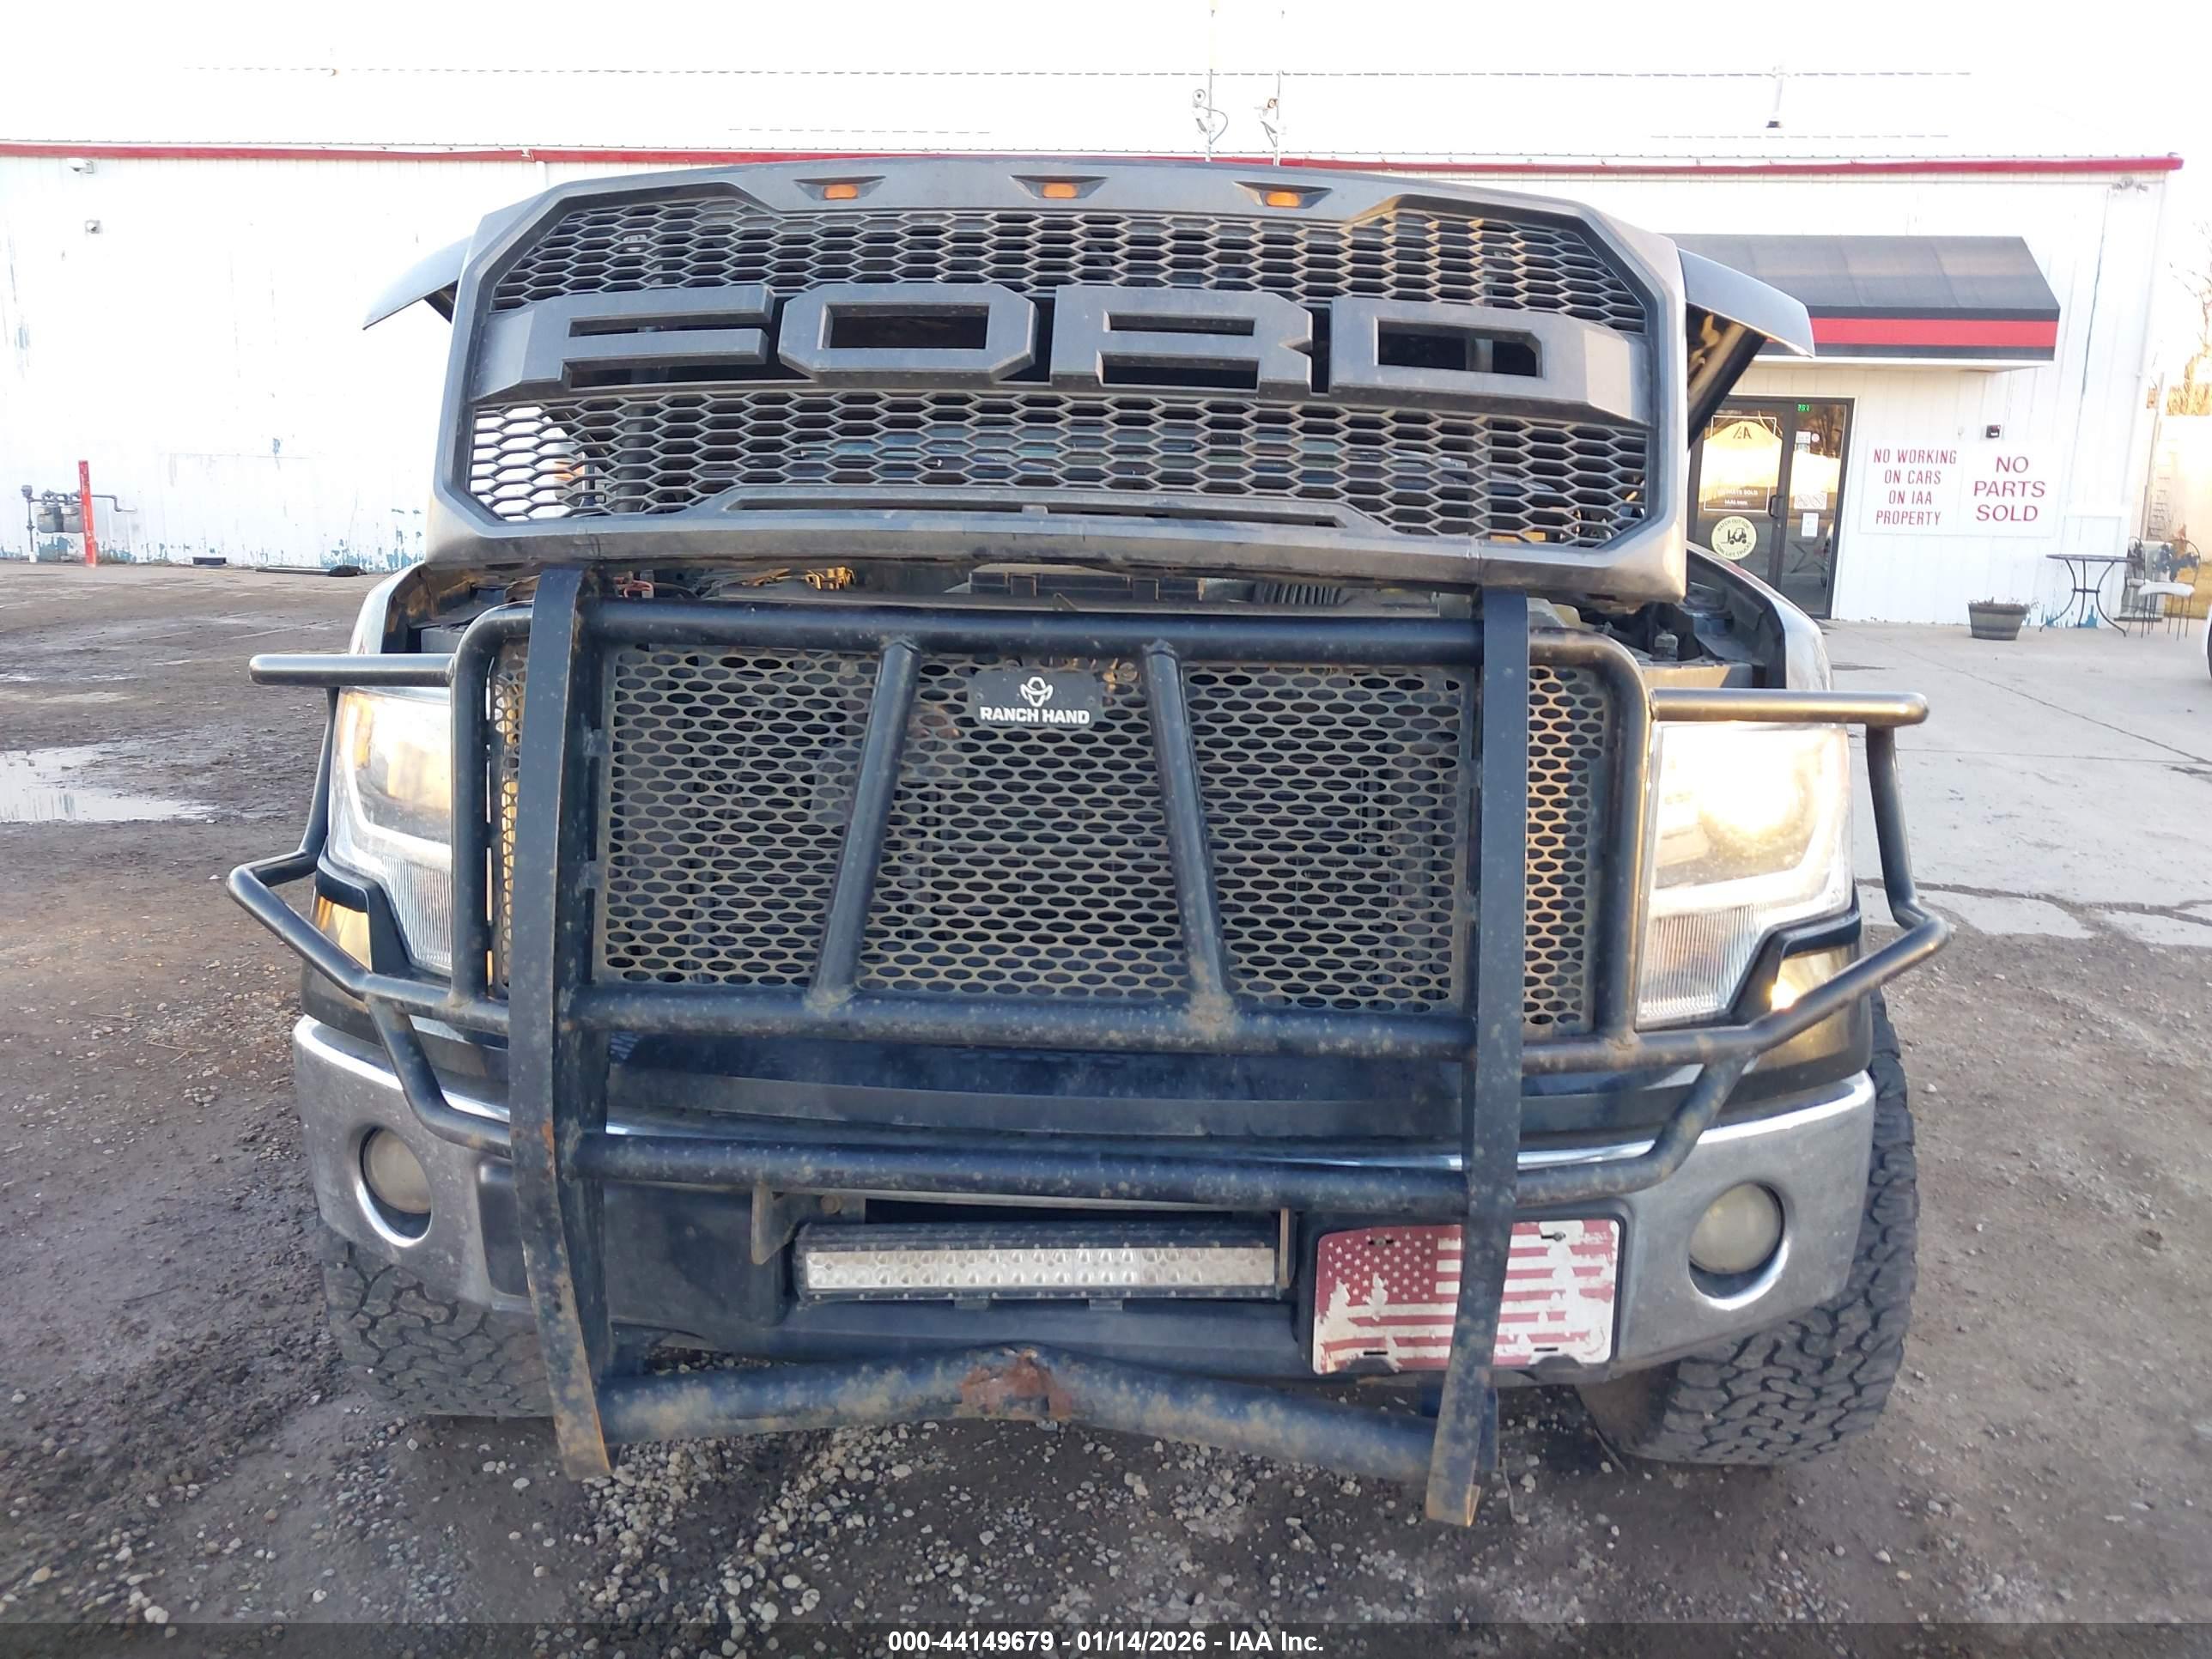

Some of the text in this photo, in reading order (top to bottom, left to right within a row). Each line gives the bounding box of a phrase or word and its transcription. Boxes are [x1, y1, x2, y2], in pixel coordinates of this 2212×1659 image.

[494, 282, 1606, 412] FORD
[1873, 448, 1957, 465] NO WORKING
[1996, 456, 2029, 474] NO
[1884, 469, 1942, 485] ON CARS
[1888, 489, 1932, 505] ON IAA
[1973, 480, 2045, 498] PARTS
[1875, 510, 1941, 526] PROPERTY
[1976, 504, 2039, 522] SOLD
[980, 707, 1091, 725] RANCH HAND
